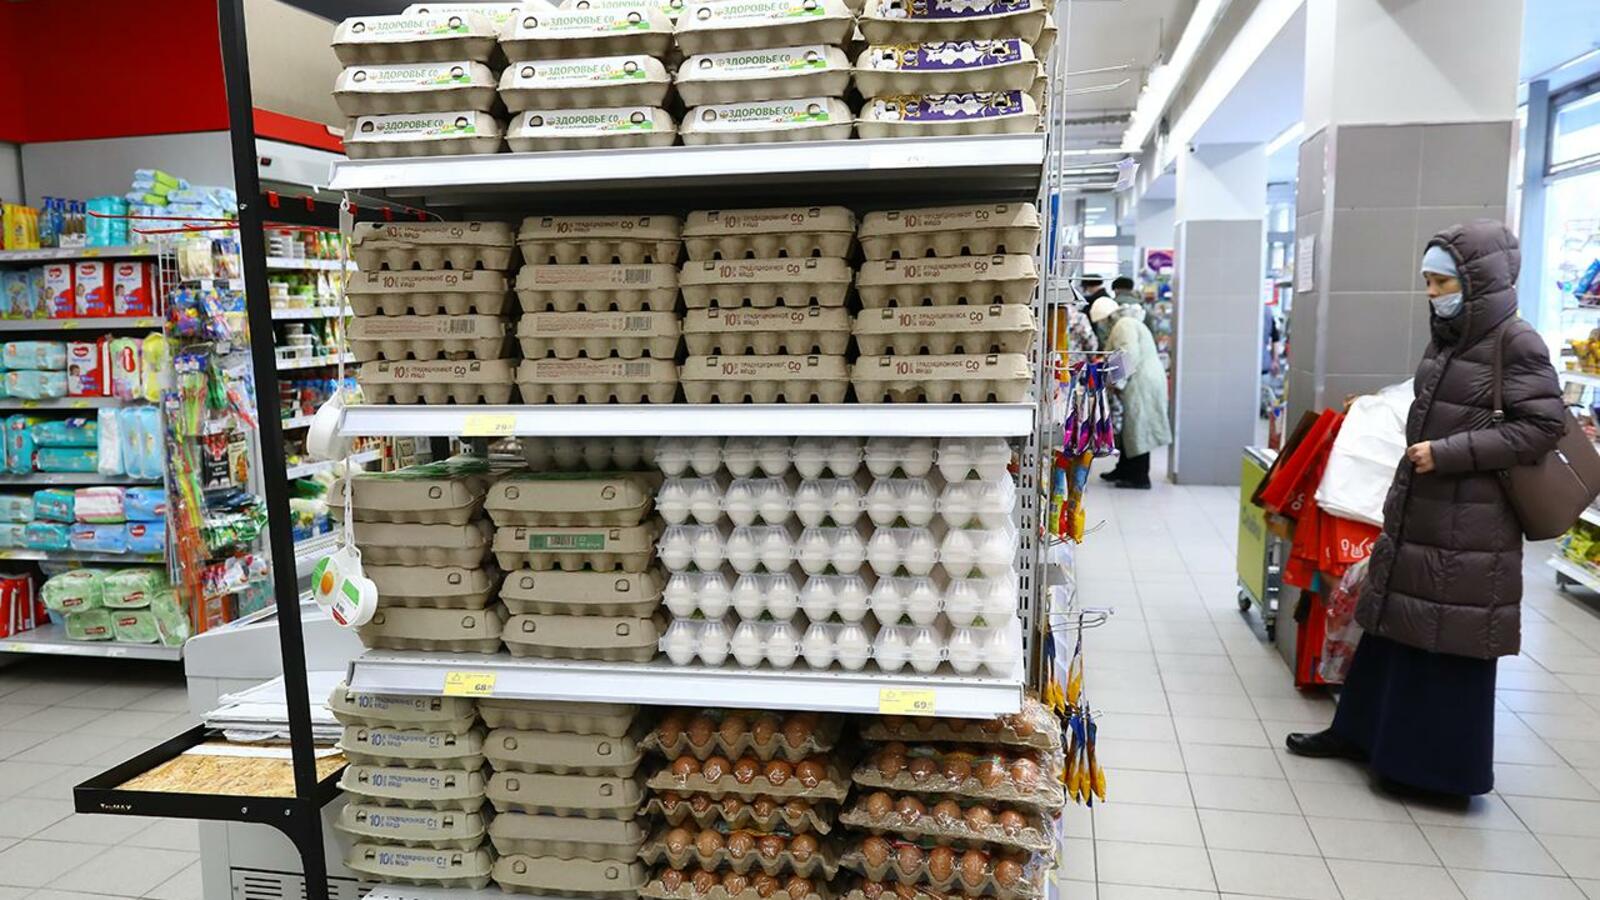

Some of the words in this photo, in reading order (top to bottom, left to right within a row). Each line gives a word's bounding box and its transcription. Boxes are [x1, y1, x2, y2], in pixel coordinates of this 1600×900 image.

[727, 55, 777, 66] ЗДОРОВЬЕ
[549, 65, 599, 76] ЗДОРОВЬЕ
[556, 114, 606, 125] ЗДОРОВЬЕ
[730, 107, 781, 119] ЗДОРОВЬЕ
[385, 120, 431, 131] ЗДОРОВЬЕ
[557, 222, 568, 233] 10
[726, 216, 737, 228] 10
[905, 214, 916, 228] 10
[387, 226, 398, 237] 10
[720, 264, 732, 278] 10
[905, 264, 916, 278] 10
[384, 276, 395, 288] 10
[725, 313, 736, 326] 10
[899, 314, 911, 327] 10
[394, 366, 405, 379] 10
[722, 362, 734, 376] 10
[896, 362, 909, 375] 10
[360, 695, 370, 708] 10
[372, 733, 382, 747] 10
[373, 773, 383, 787] 10
[370, 813, 381, 828] 10
[379, 851, 390, 865] 10
